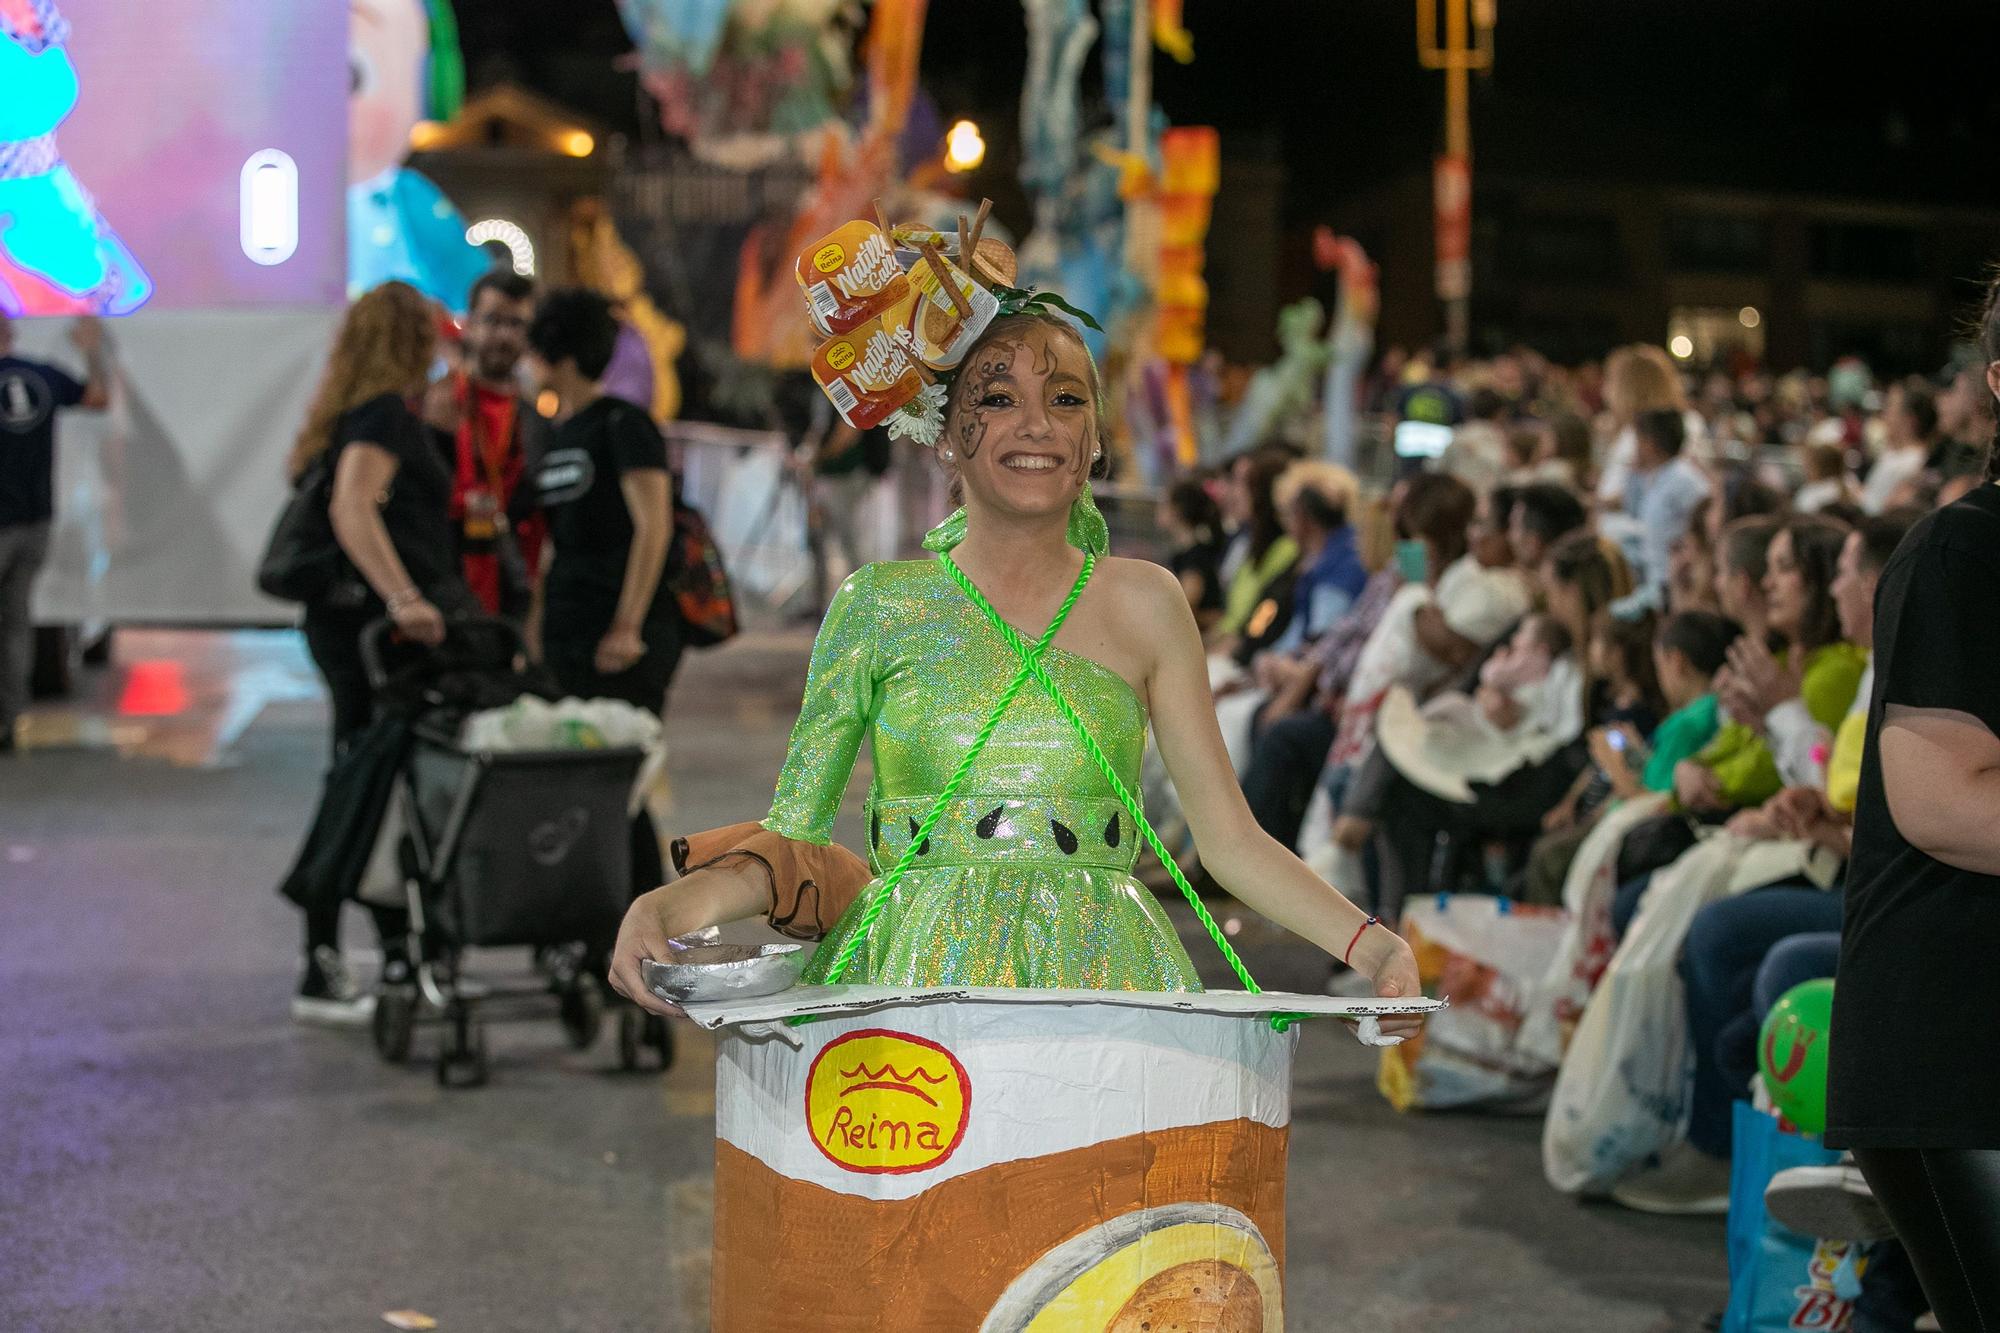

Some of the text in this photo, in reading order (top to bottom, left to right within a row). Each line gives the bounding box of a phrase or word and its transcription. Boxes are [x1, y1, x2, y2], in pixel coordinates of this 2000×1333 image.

[820, 253, 843, 271] Reina
[833, 350, 854, 369] Reina
[826, 1105, 944, 1151] Reina
